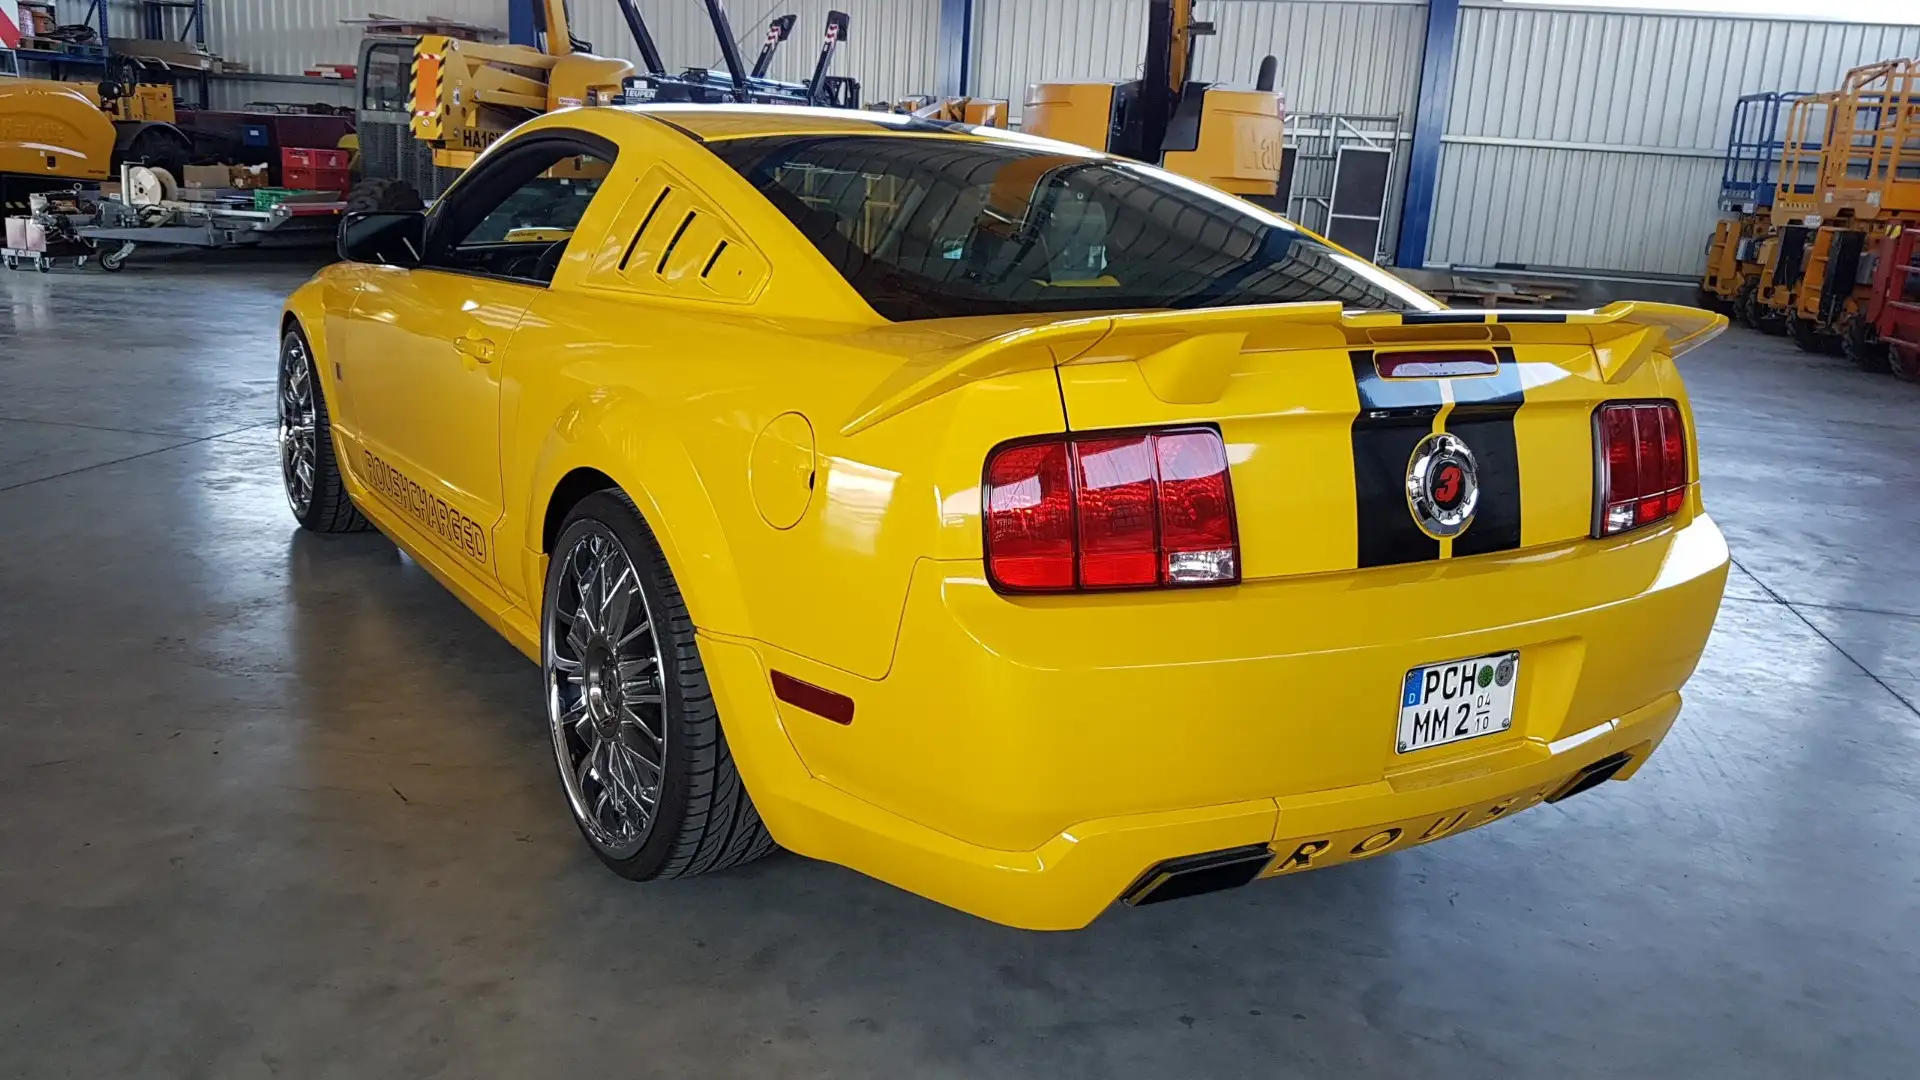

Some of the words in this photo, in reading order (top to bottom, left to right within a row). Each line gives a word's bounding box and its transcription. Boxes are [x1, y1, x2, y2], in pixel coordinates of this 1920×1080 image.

[625, 87, 656, 99] TEUPEN
[463, 129, 503, 148] HA16
[1435, 466, 1461, 502] 3
[1428, 495, 1471, 520] STAGE
[1424, 664, 1477, 704] PCH
[1408, 692, 1416, 705] D
[1476, 692, 1491, 709] 04
[1411, 706, 1450, 745] MM
[1454, 703, 1471, 736] 2
[1475, 716, 1489, 732] 10
